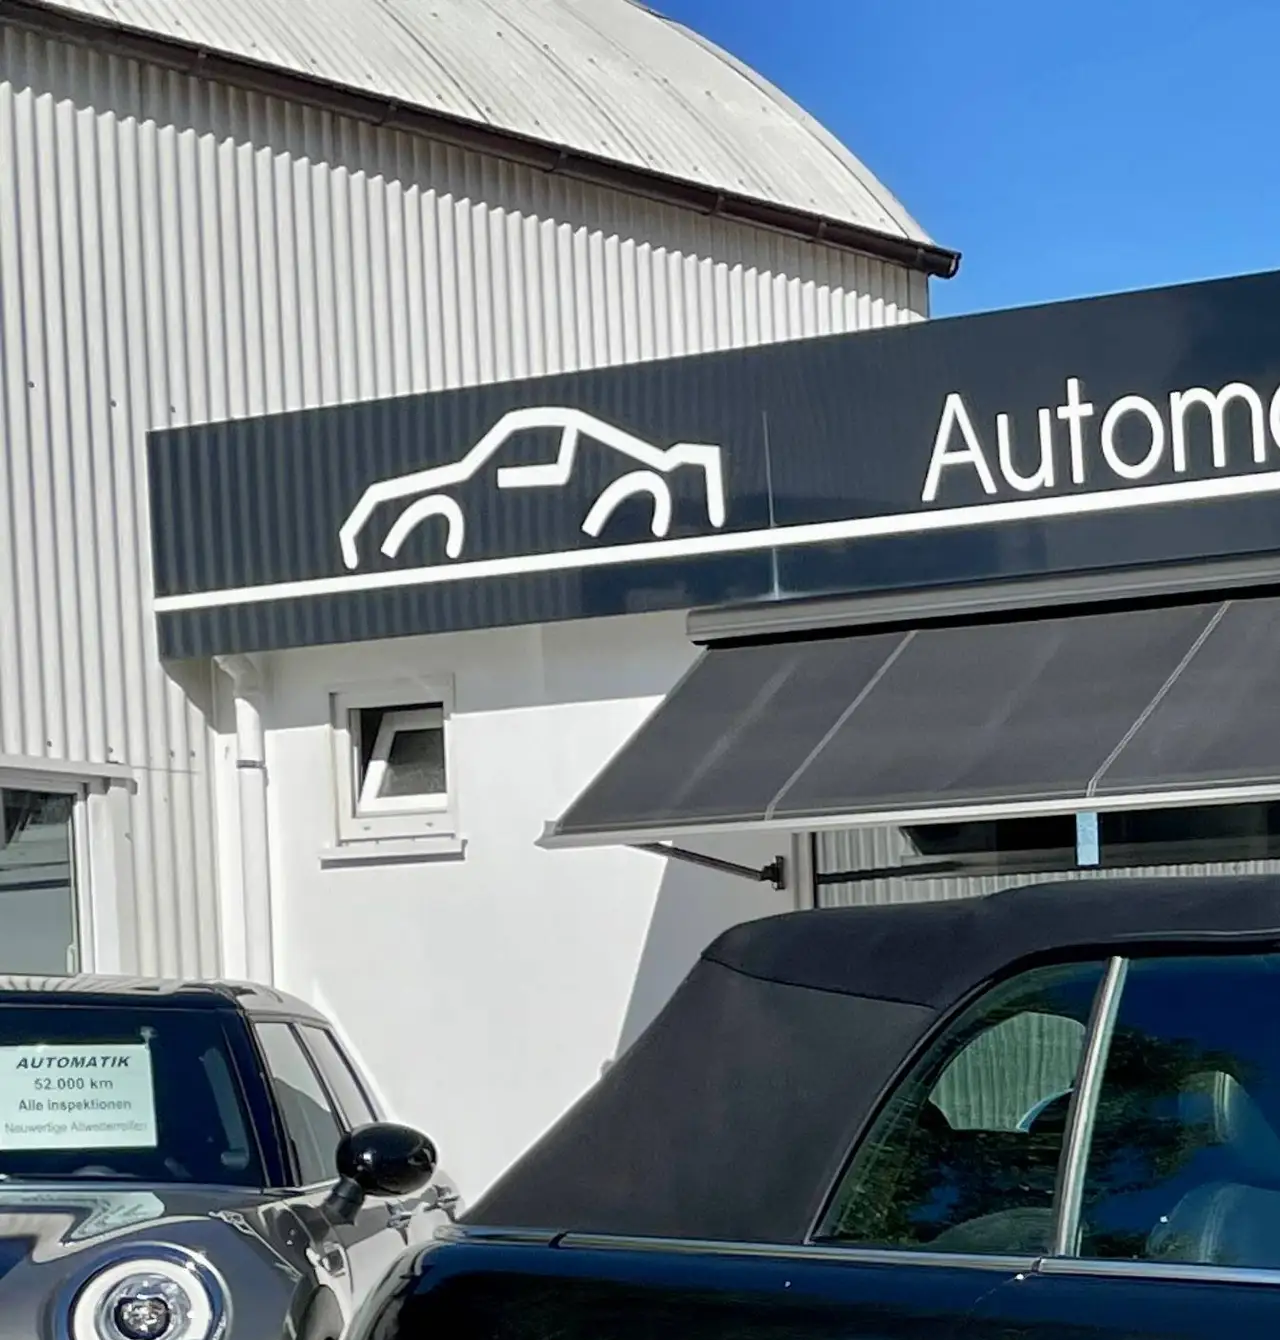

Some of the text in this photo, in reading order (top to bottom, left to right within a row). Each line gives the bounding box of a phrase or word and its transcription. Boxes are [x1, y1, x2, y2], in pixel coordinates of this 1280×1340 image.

[16, 1056, 131, 1069] AUTOMATIK
[34, 1078, 114, 1090] 52.000 km
[18, 1099, 44, 1111] Alle
